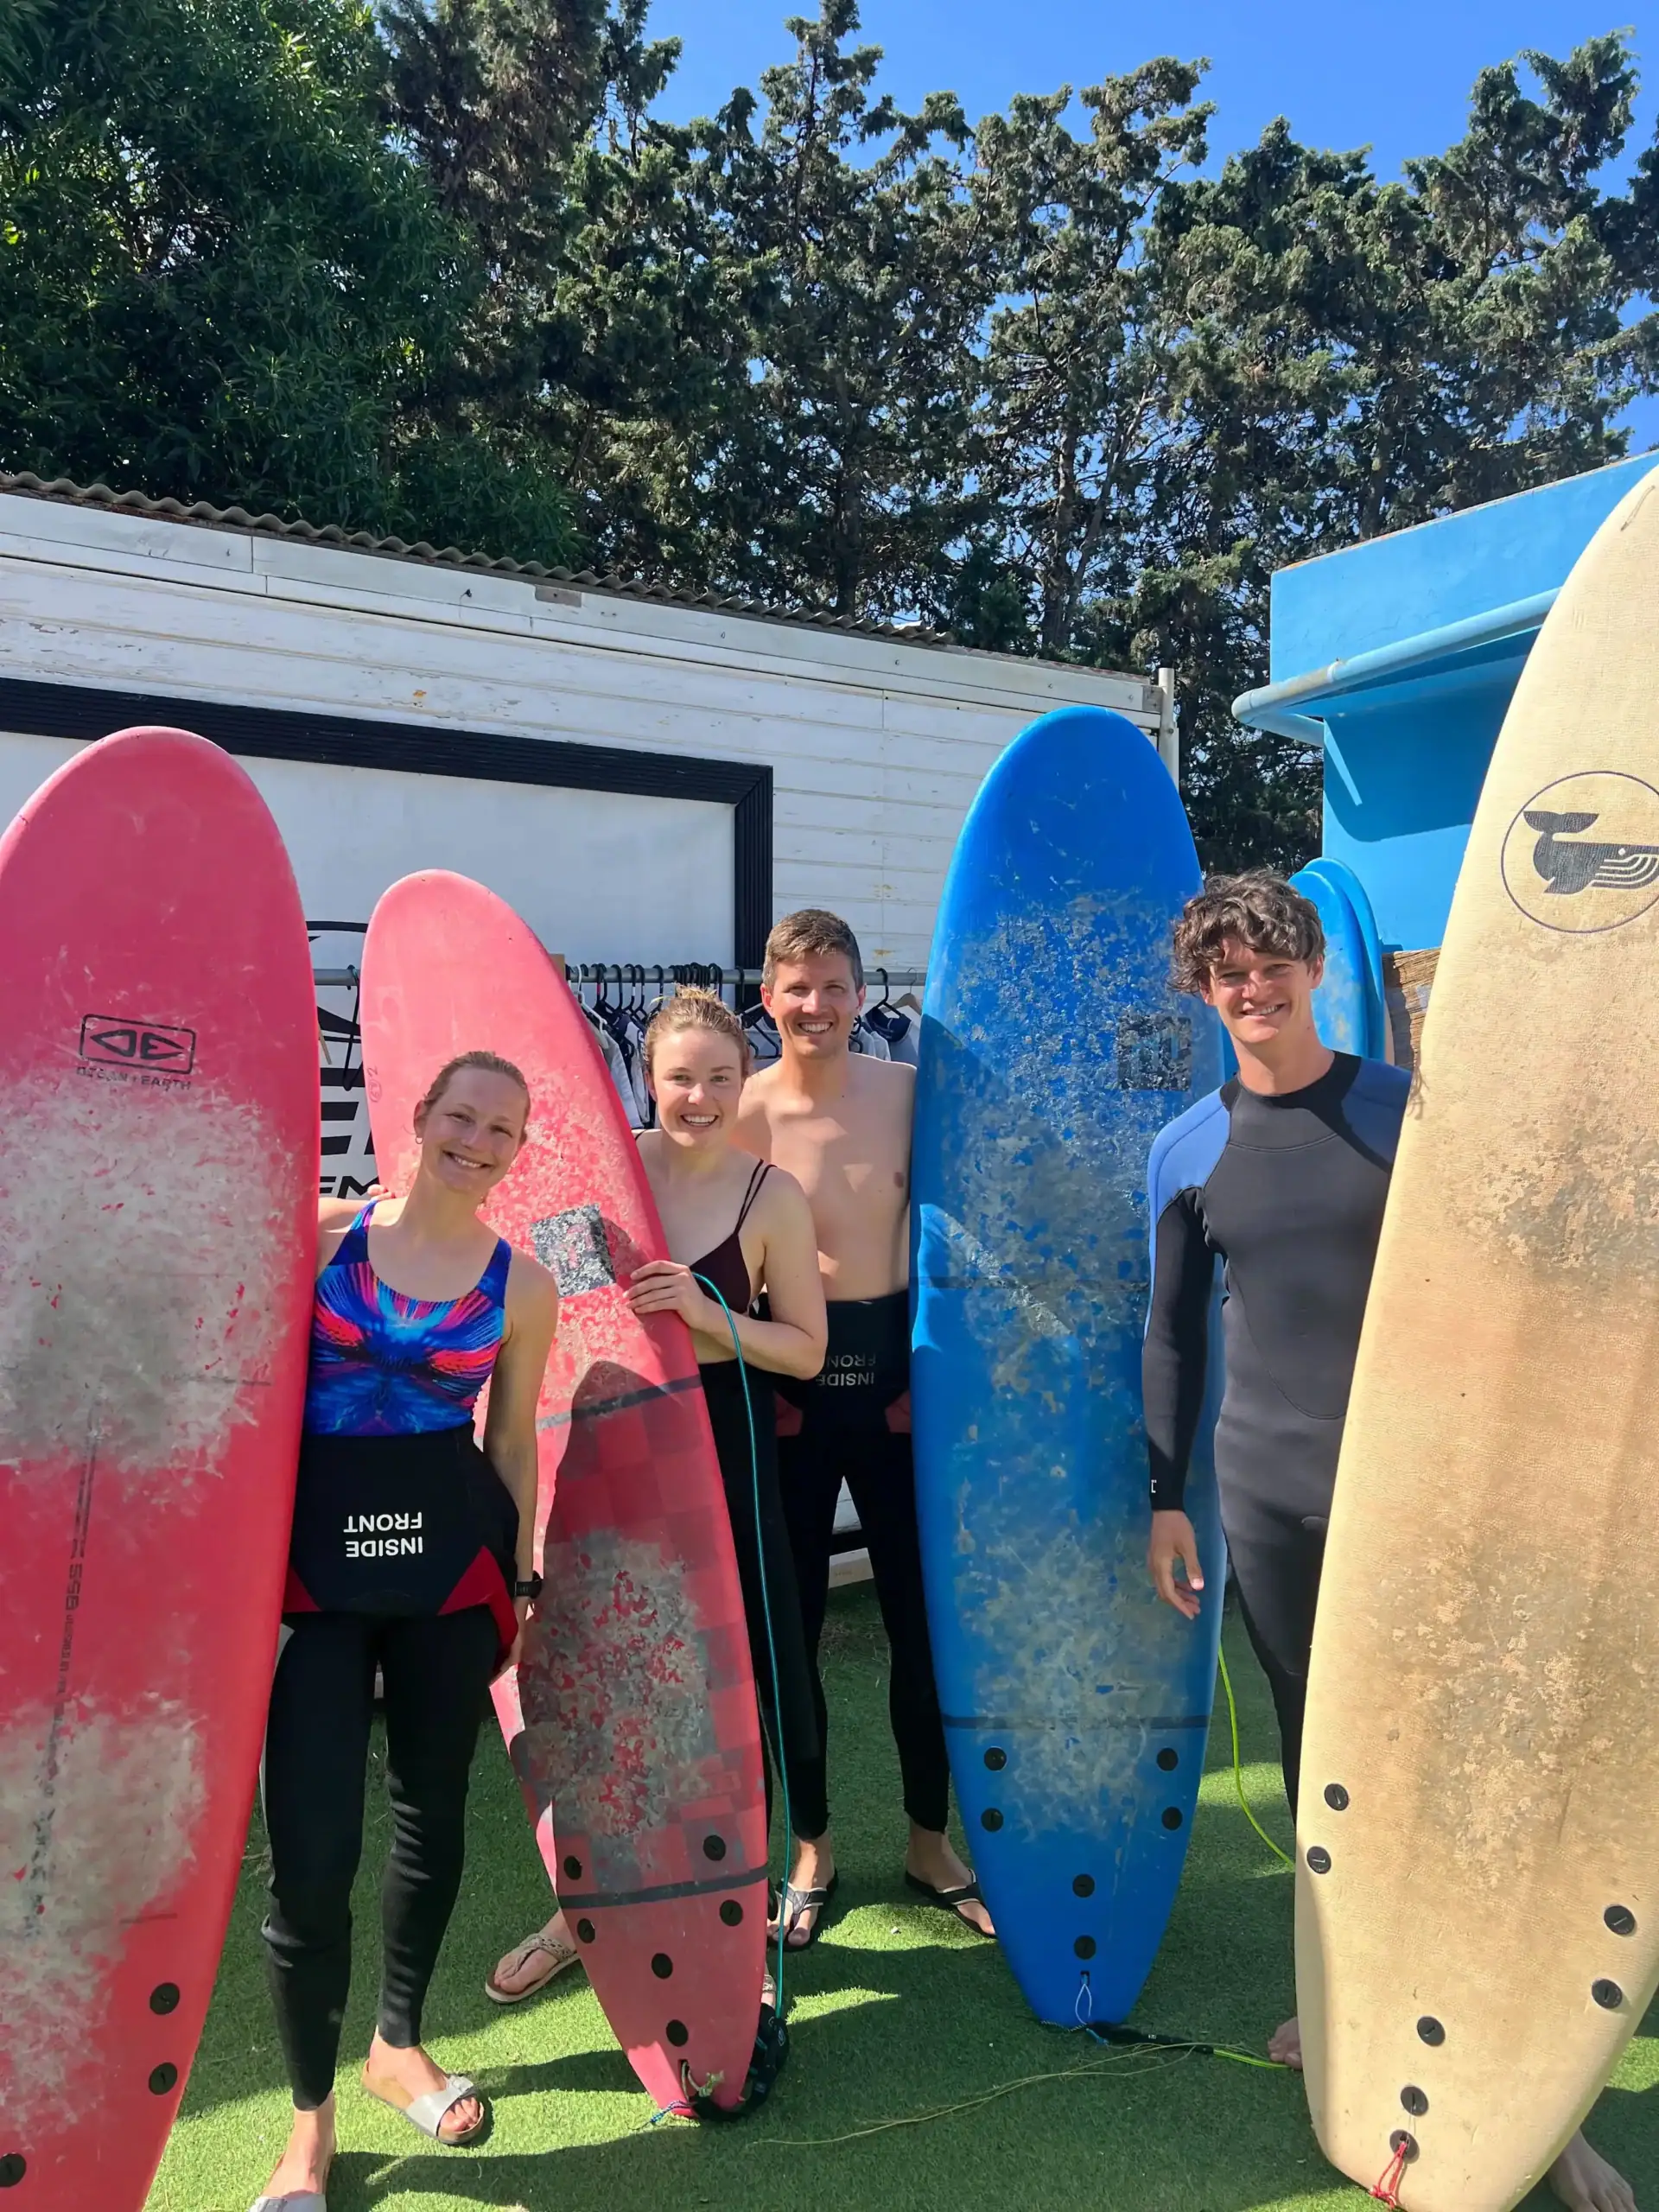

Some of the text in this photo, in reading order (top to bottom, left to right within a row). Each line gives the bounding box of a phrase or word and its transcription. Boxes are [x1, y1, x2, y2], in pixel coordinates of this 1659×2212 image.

[141, 1075, 191, 1090] EARTH
[827, 1353, 876, 1369] FRON
[815, 1371, 874, 1387] INSIDE
[343, 1511, 423, 1533] FRONT
[345, 1536, 423, 1558] INSIDE
